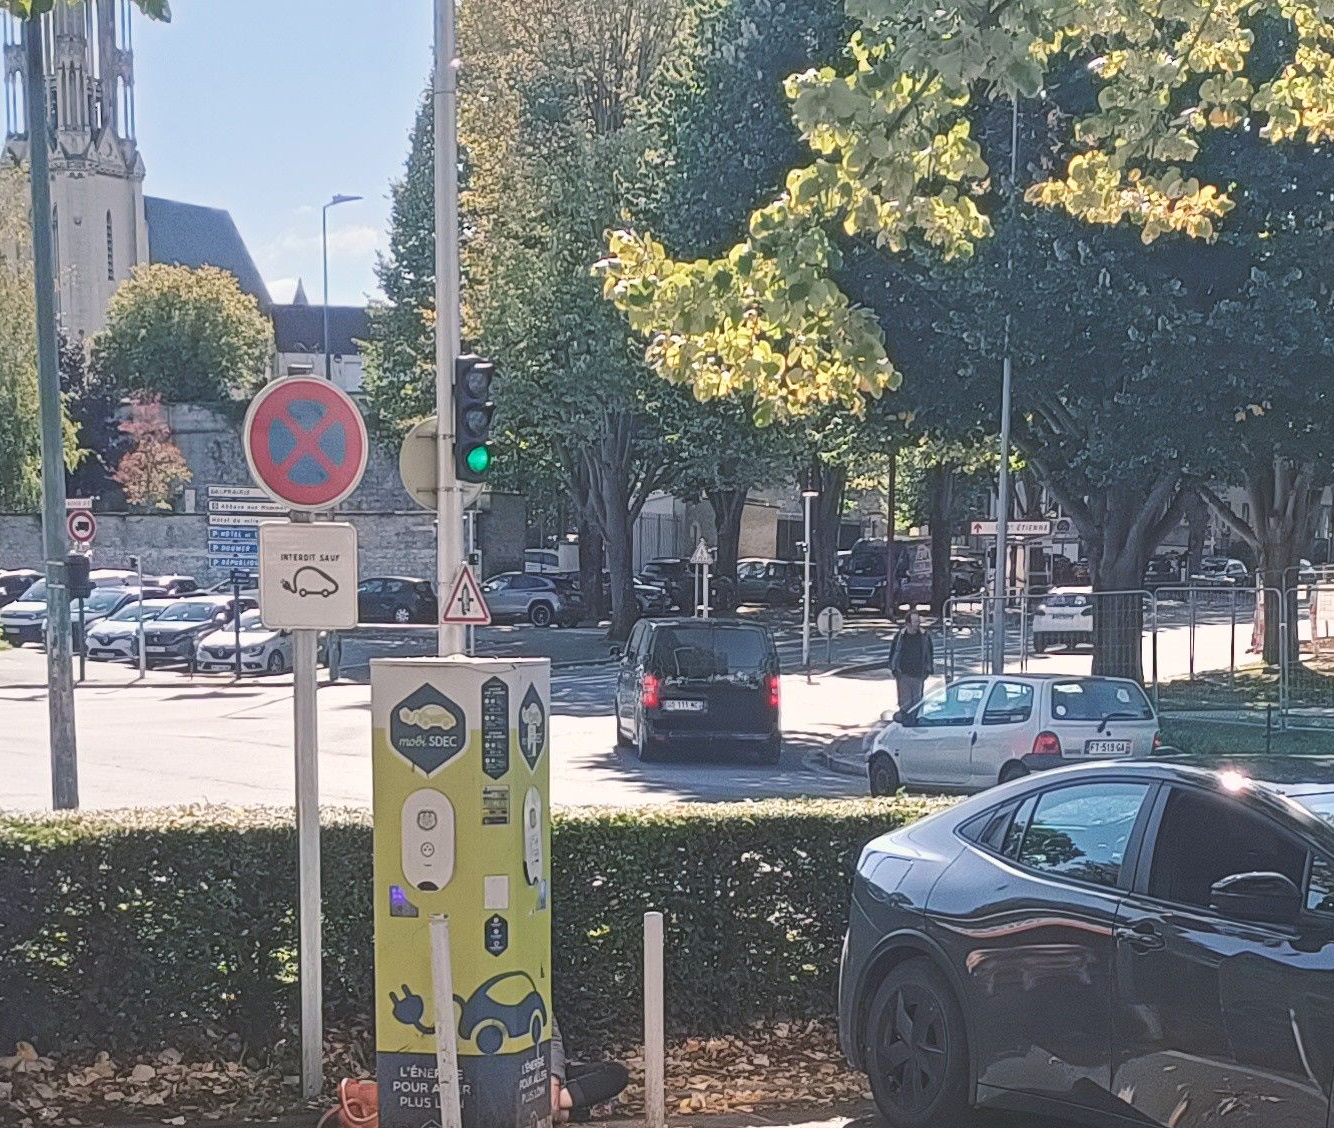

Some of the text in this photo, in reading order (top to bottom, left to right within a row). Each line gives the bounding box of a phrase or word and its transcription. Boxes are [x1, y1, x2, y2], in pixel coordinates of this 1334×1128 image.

[280, 553, 340, 562] INTERDIT SAUF
[428, 735, 458, 747] SDEC
[393, 1081, 429, 1093] POUR
[400, 1096, 432, 1109] PLUS
